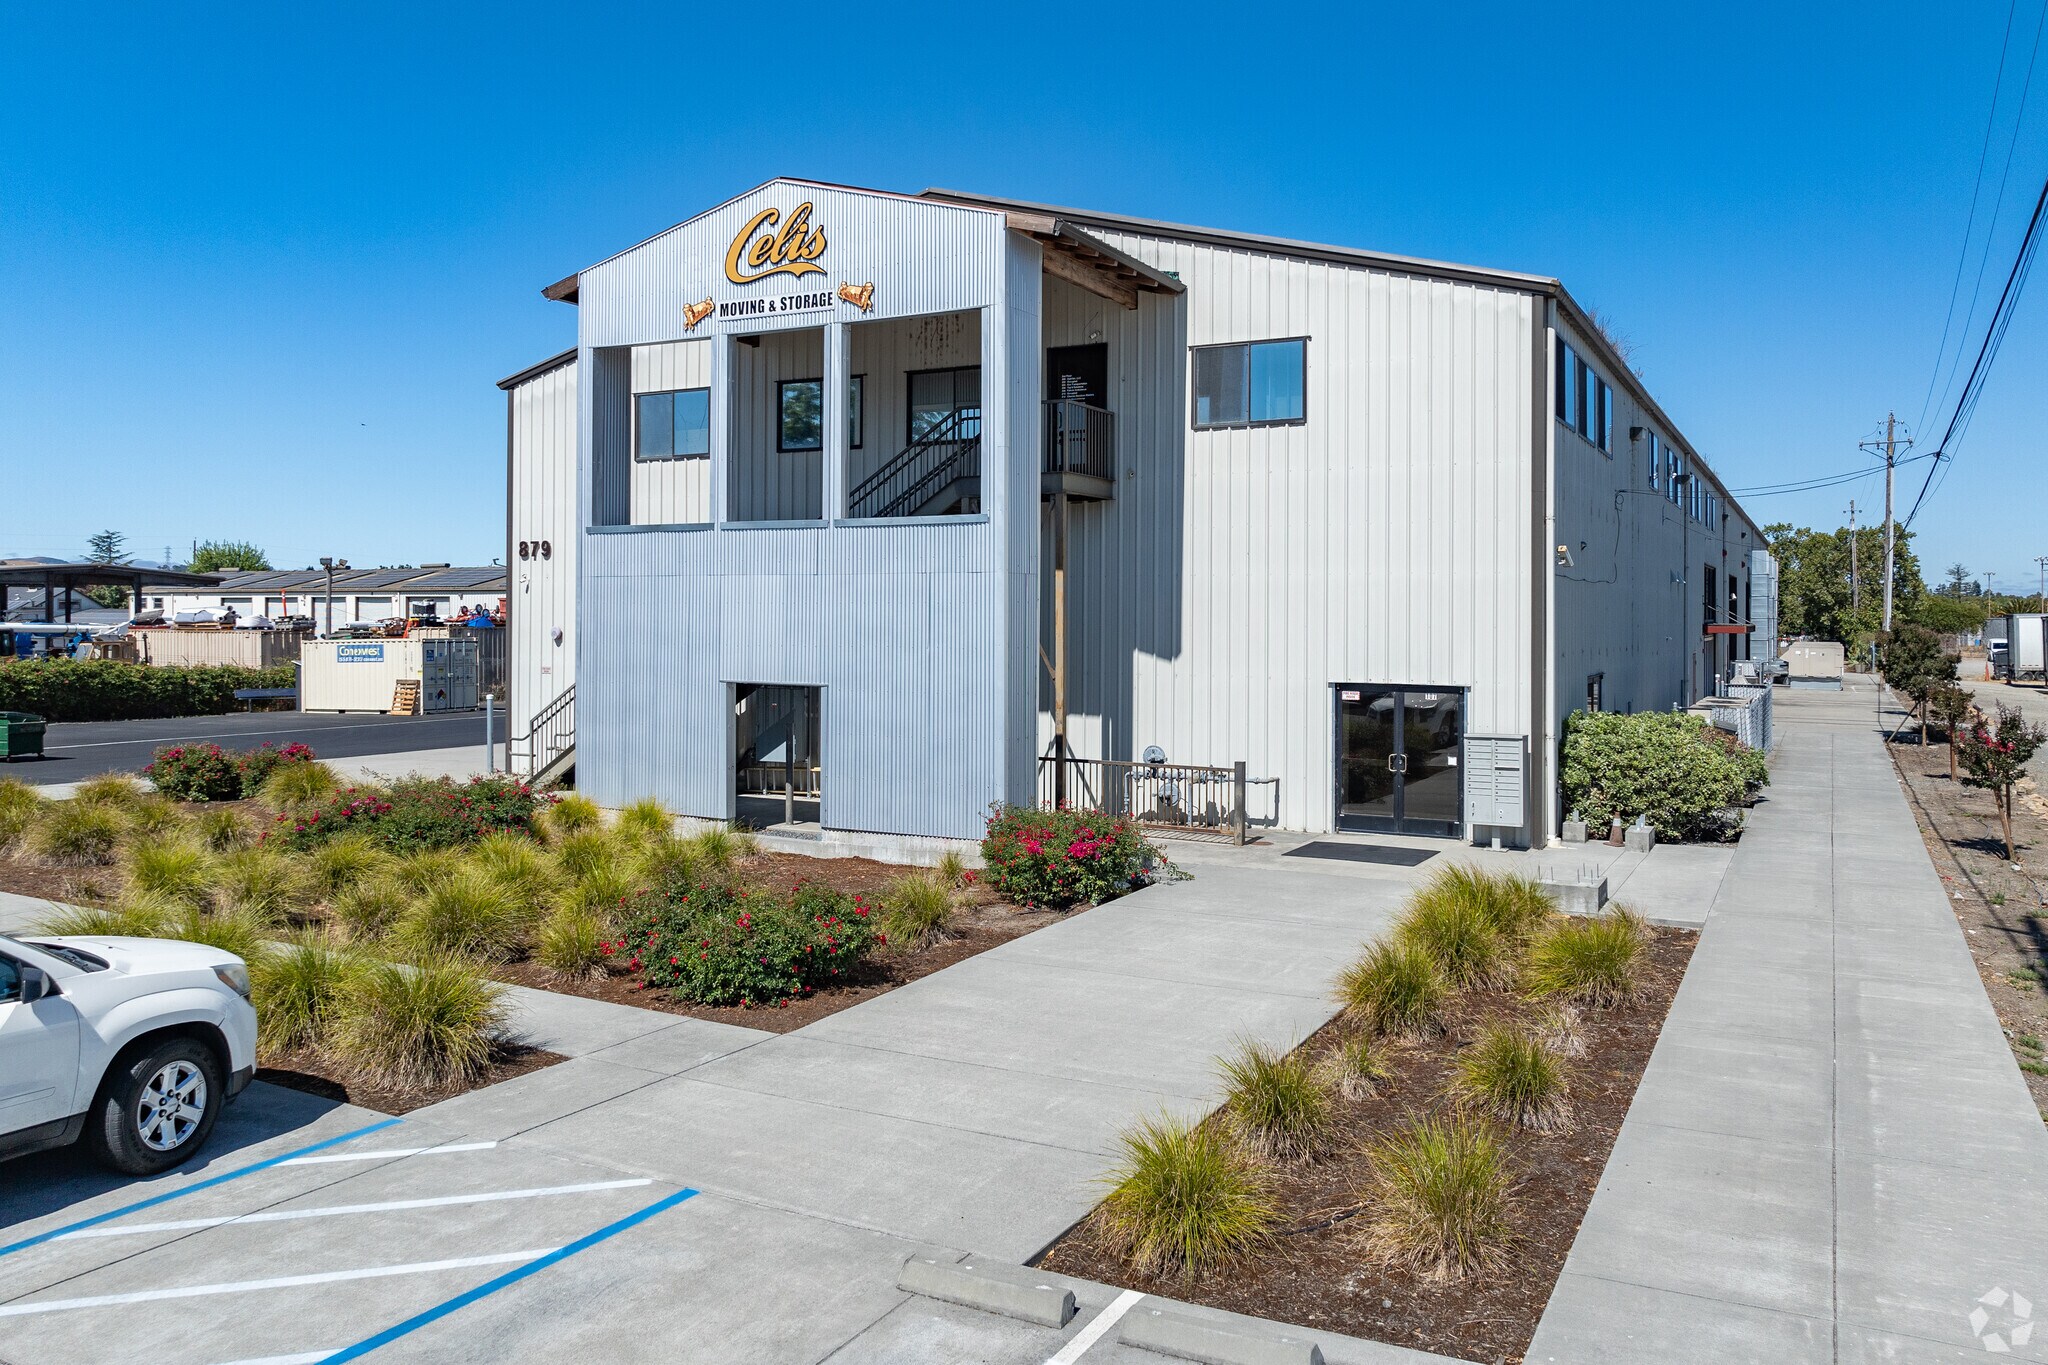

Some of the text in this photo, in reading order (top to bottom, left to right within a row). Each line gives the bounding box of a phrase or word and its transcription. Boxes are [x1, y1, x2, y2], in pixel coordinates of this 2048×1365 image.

[724, 202, 827, 283] Celis
[719, 292, 833, 317] MOVING & STORAGE
[519, 540, 551, 560] 879
